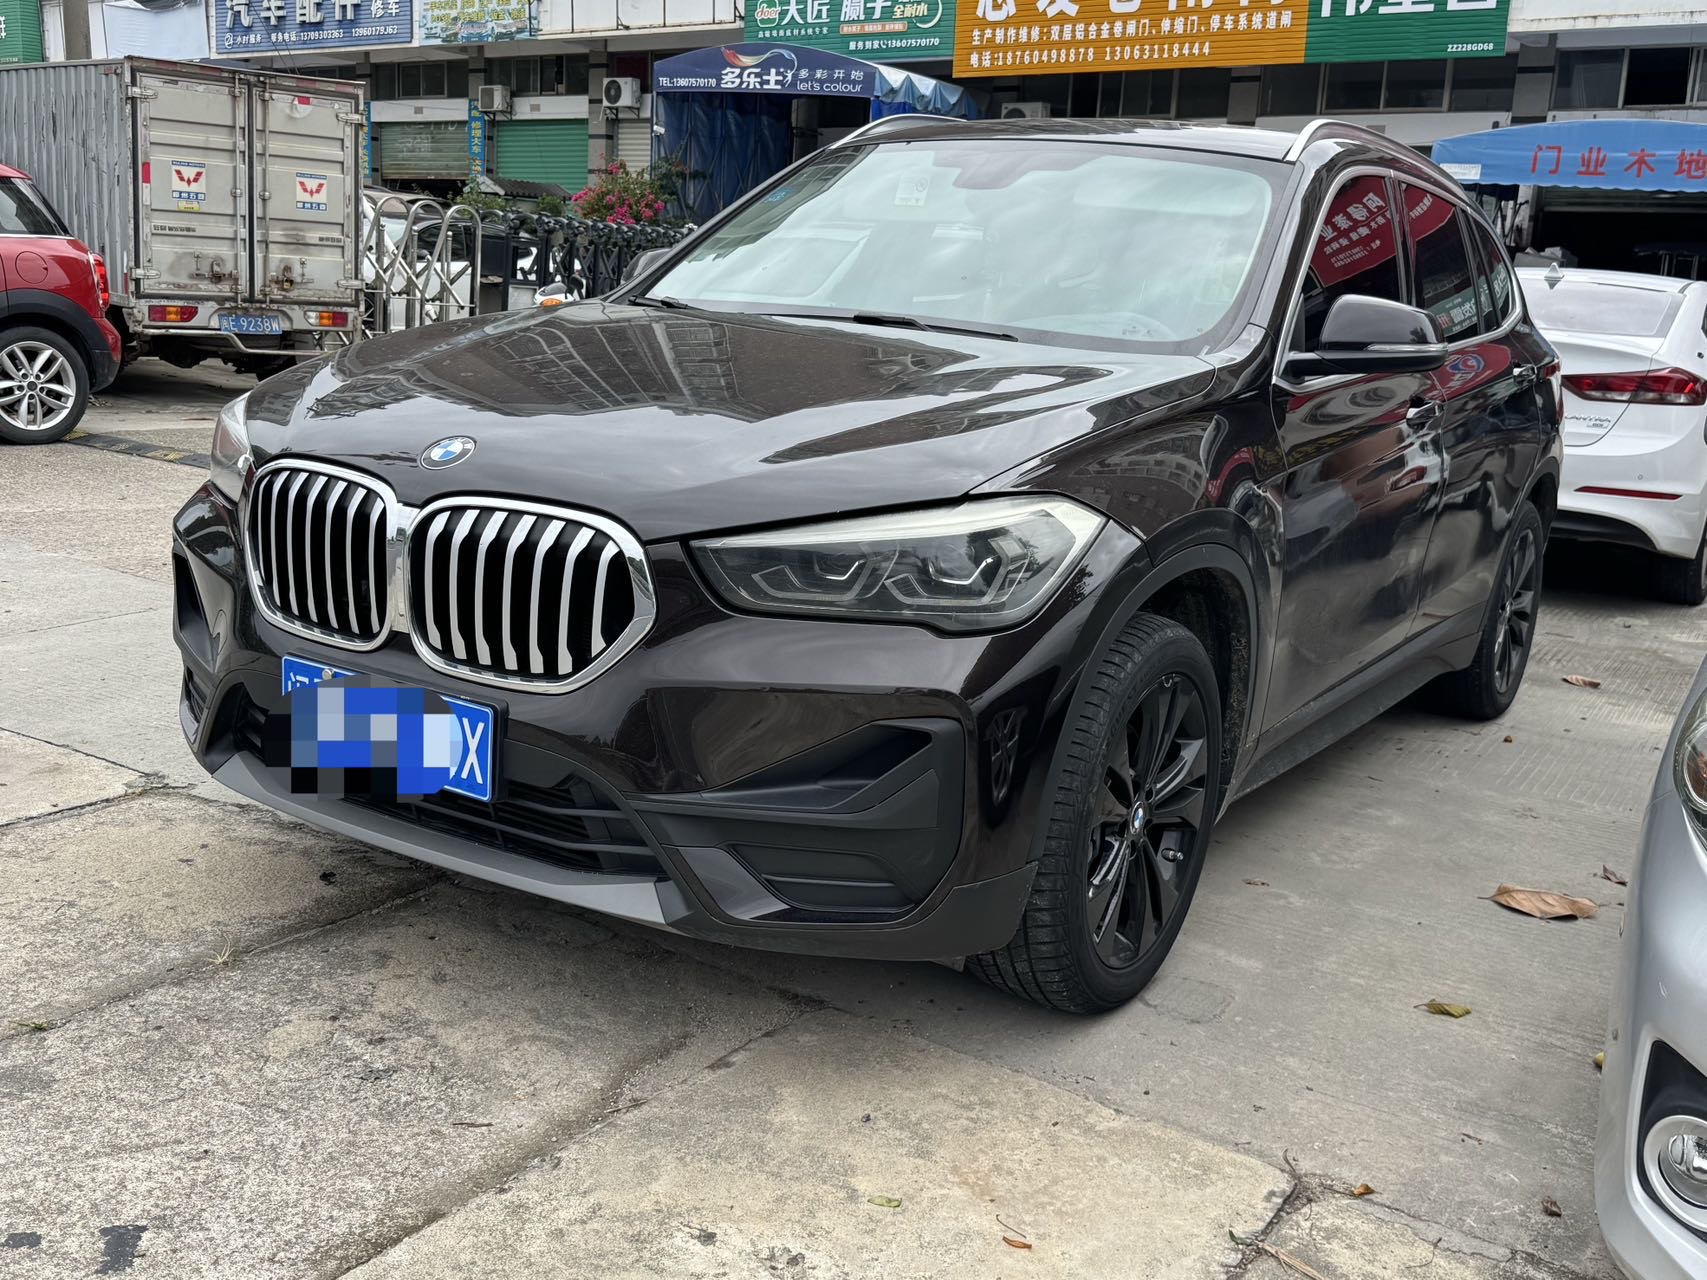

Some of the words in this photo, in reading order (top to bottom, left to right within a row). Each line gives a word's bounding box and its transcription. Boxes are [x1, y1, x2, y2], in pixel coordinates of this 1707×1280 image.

[1104, 41, 1211, 61] 13063118444
[720, 67, 783, 90] 多乐士
[797, 80, 821, 91] let's
[822, 82, 863, 93] colour
